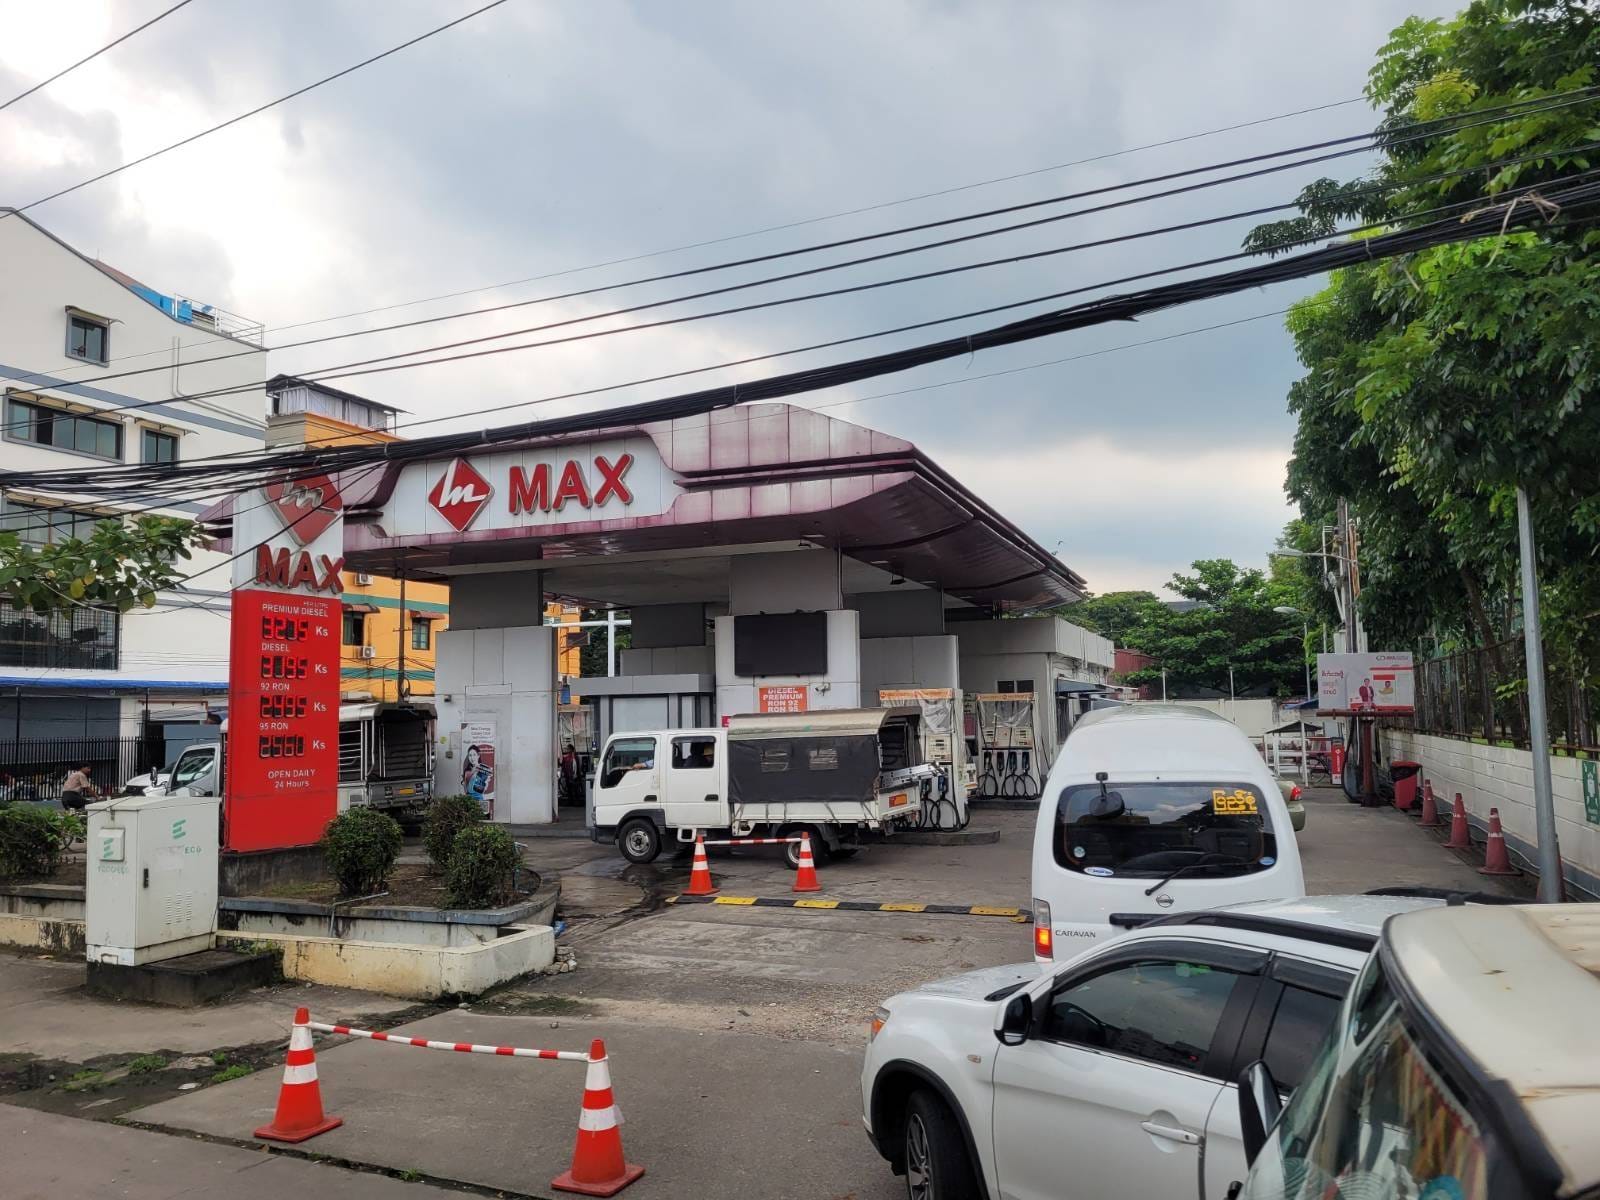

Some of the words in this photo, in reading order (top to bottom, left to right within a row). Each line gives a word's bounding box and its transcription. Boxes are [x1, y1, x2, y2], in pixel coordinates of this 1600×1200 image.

[509, 453, 634, 515] MAX
[255, 543, 345, 593] MAX
[262, 603, 299, 615] PREMIUM
[301, 607, 328, 617] DIESEL
[315, 626, 328, 636] Ks
[261, 642, 290, 652] DIESEL
[314, 663, 328, 674] Ks
[260, 683, 270, 691] 92
[272, 683, 290, 691] RON
[763, 693, 803, 701] PREMIUM
[313, 702, 327, 712] Ks
[259, 722, 268, 731] 95
[270, 722, 288, 730] RON
[312, 740, 325, 750] Ks
[268, 770, 291, 779] OPEN
[293, 769, 316, 777] DAILY
[286, 780, 310, 788] Hours
[1055, 930, 1096, 938] CARAVAN
